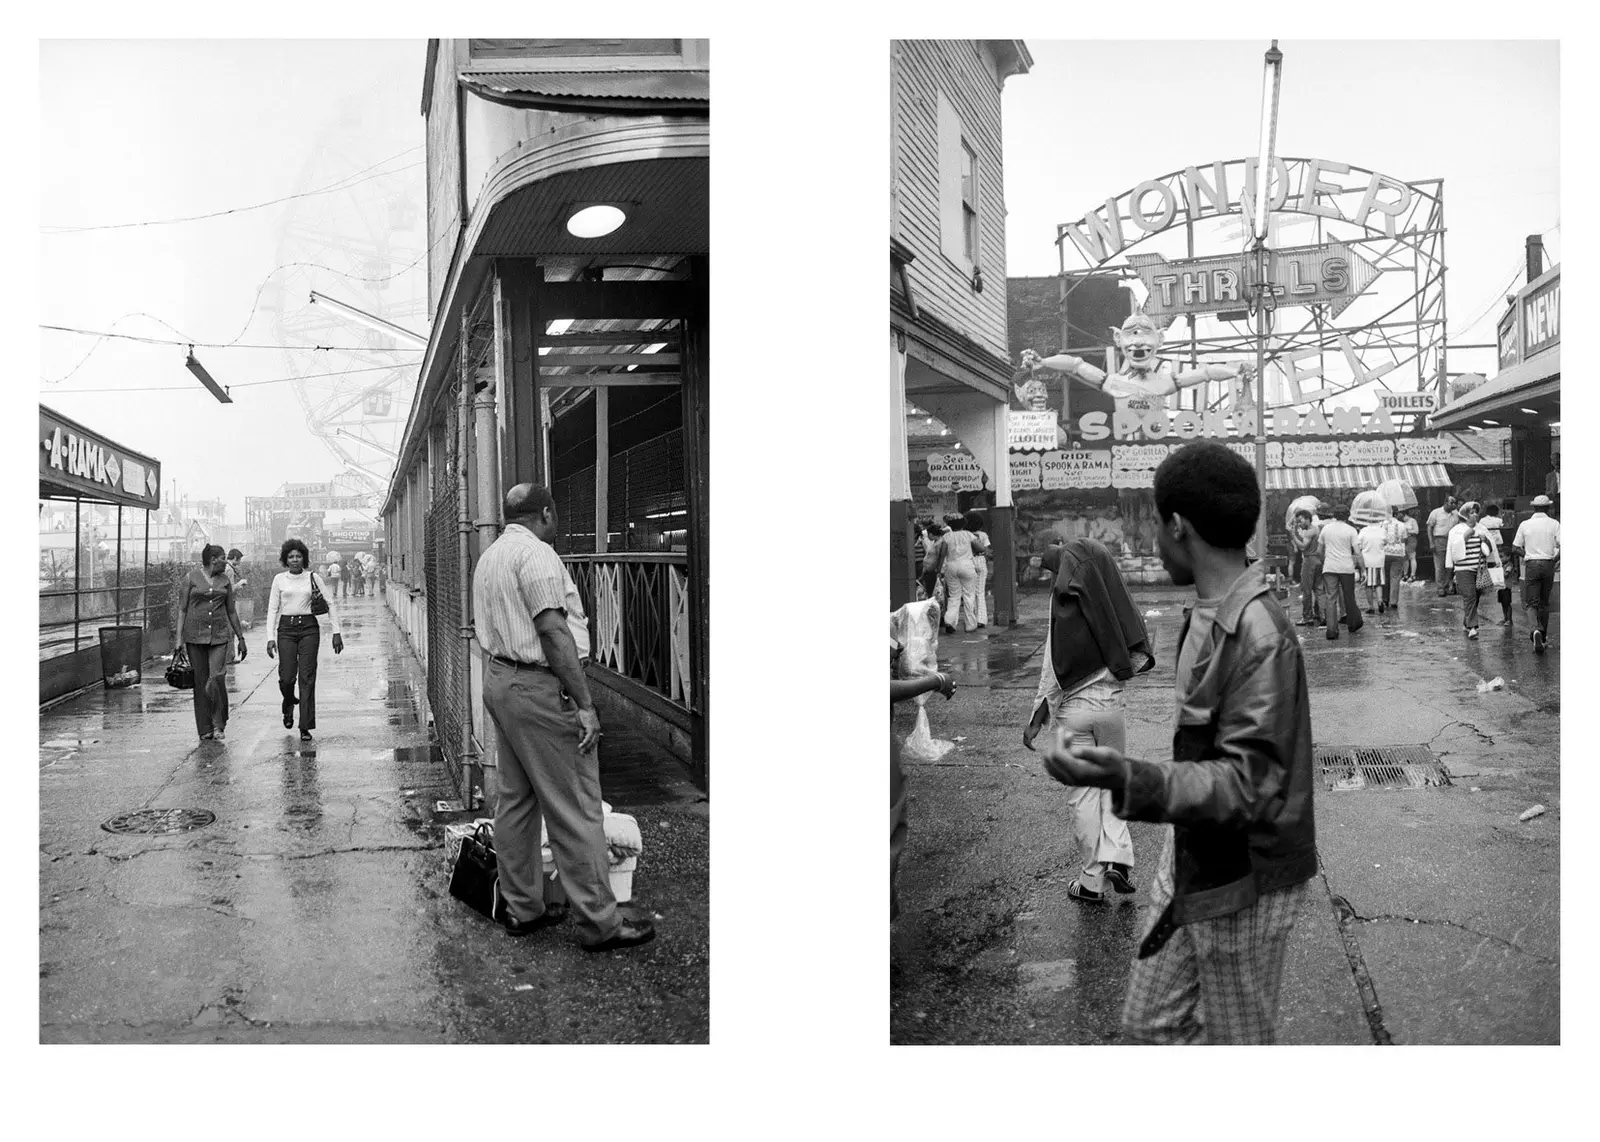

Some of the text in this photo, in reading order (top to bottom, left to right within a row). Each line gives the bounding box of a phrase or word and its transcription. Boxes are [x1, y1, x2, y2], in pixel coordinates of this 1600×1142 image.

[1067, 157, 1412, 263] WONDER
[1154, 256, 1350, 307] THRLLS
[1381, 395, 1435, 409] TOILETS
[1078, 409, 1231, 441] SPOOK
[1273, 406, 1395, 437] RAMA
[942, 454, 964, 464] See
[1045, 461, 1109, 470] SPOOK A RAMA
[286, 484, 327, 498] THRILLS
